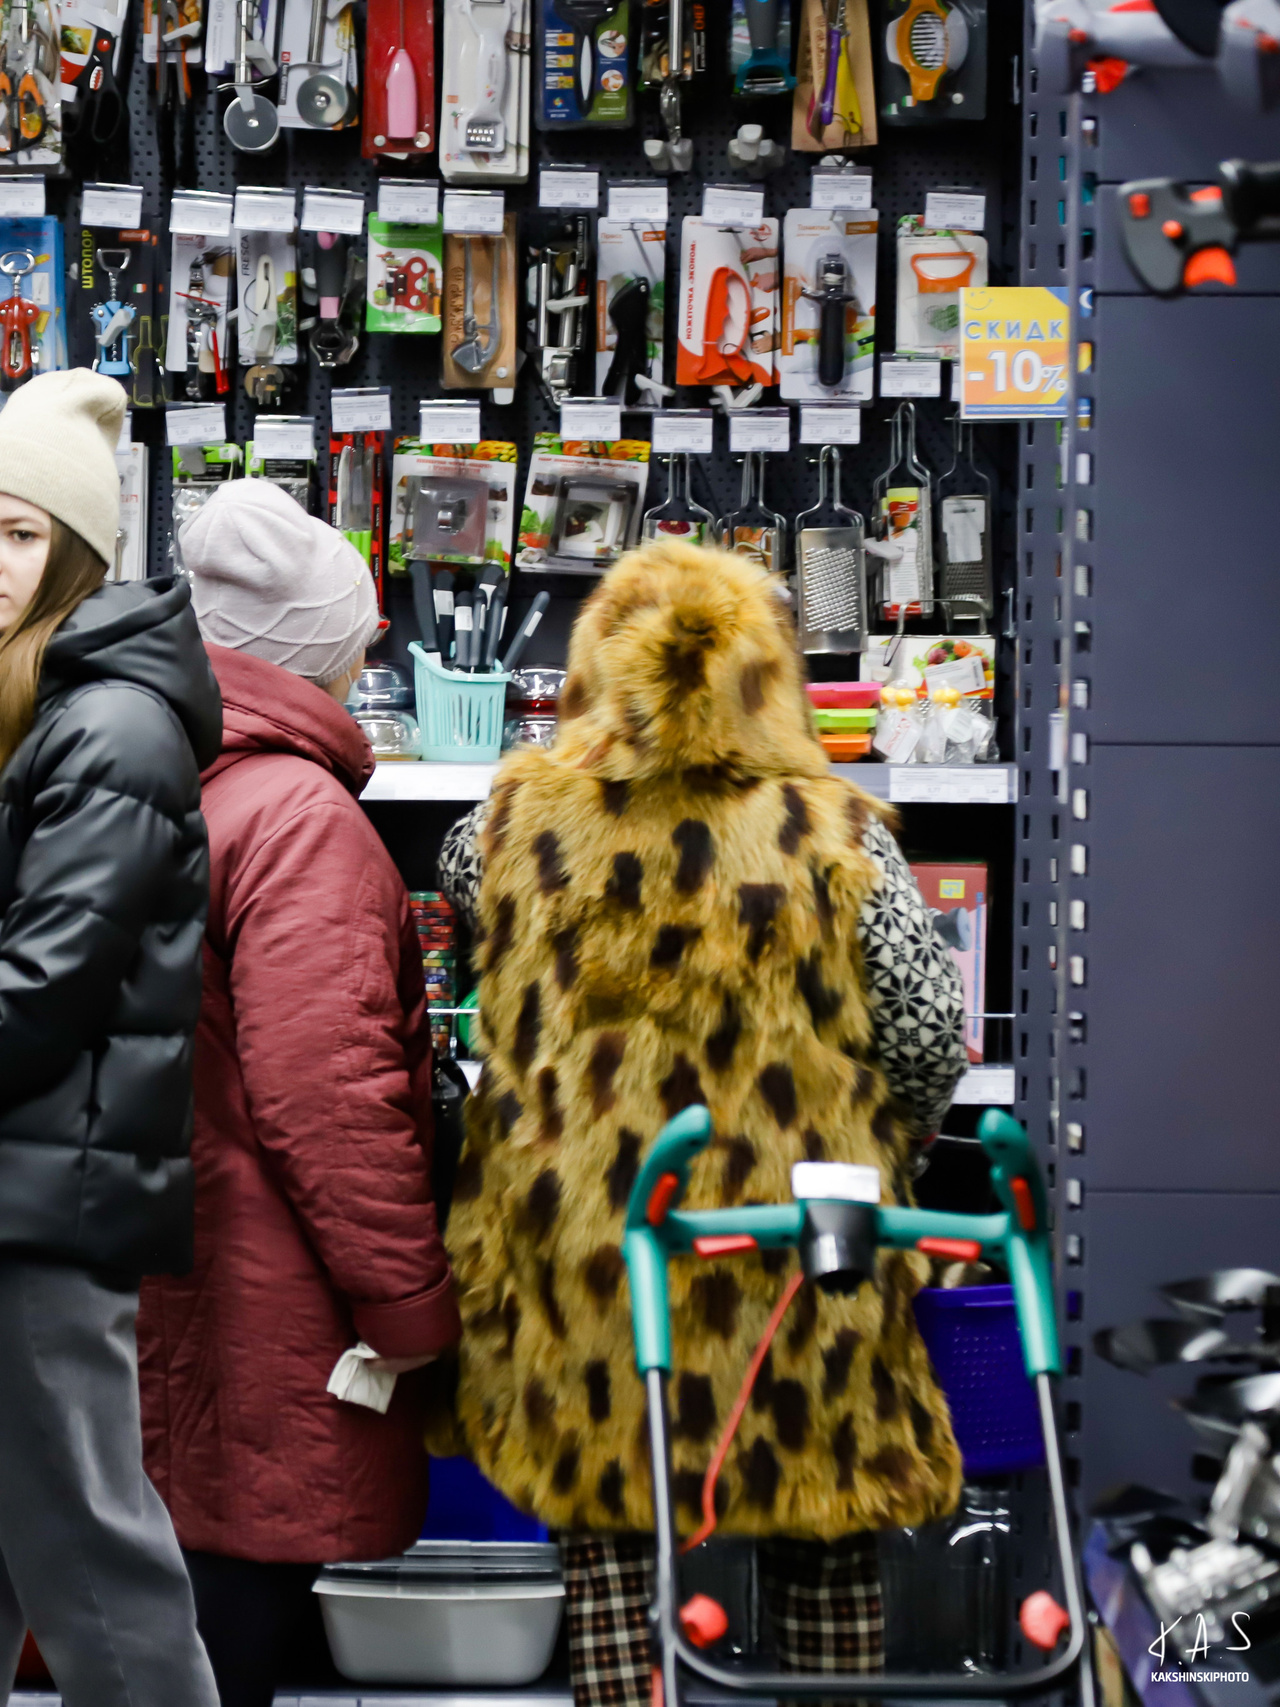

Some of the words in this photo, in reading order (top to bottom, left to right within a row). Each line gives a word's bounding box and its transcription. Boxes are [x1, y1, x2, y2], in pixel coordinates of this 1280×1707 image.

[81, 229, 95, 289] ШТОПОР
[241, 234, 251, 277] FRESCA
[685, 287, 694, 340] НОЖЕТОЧКА
[964, 320, 1065, 341] СКИДК
[966, 349, 1068, 393] -10%
